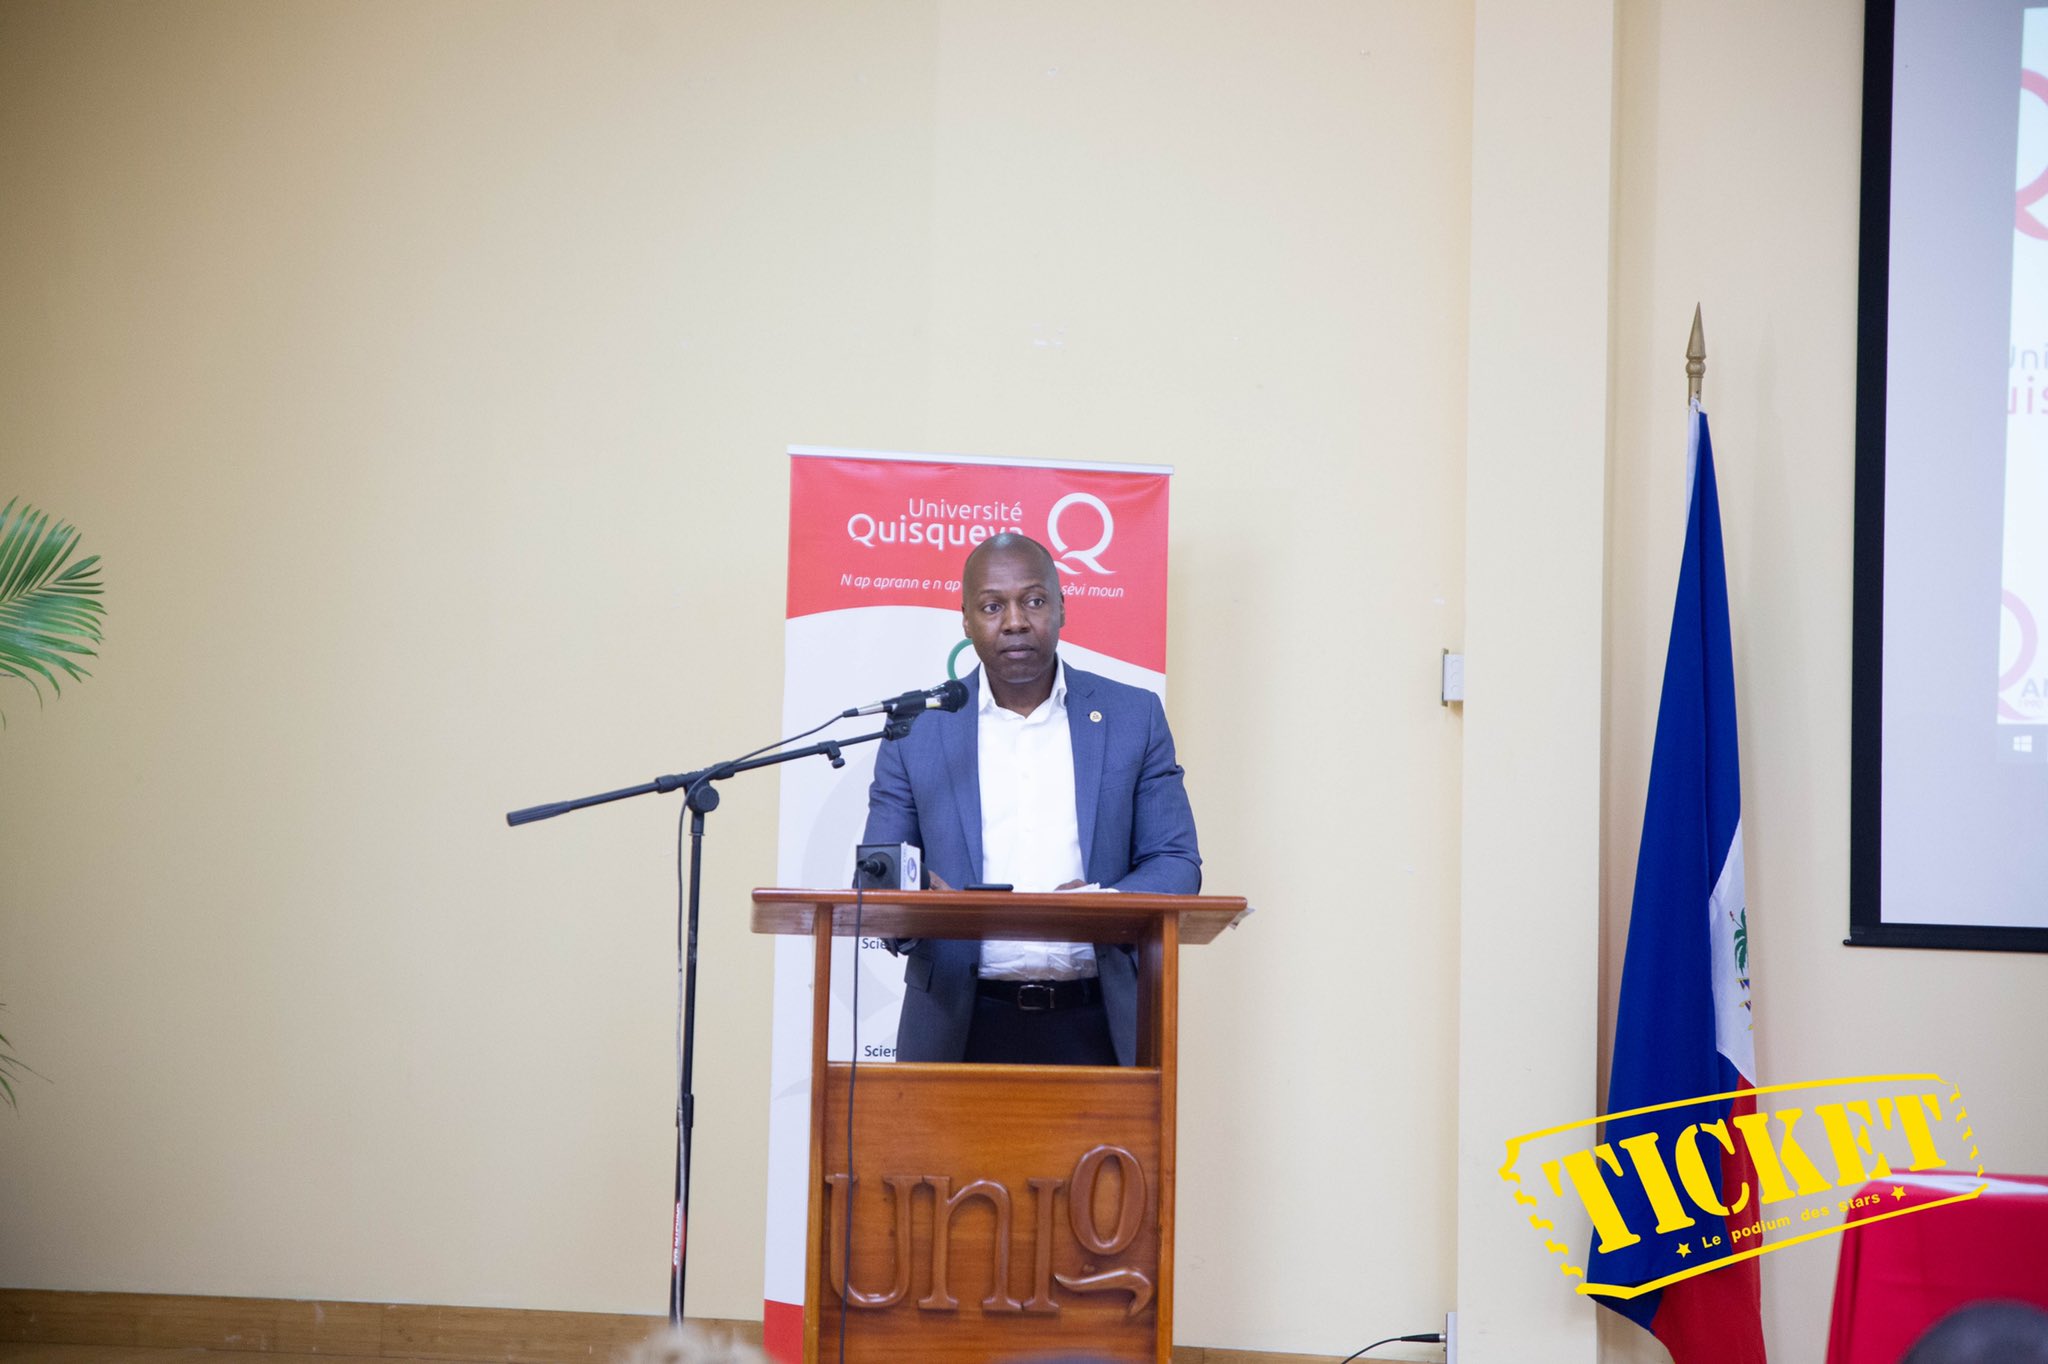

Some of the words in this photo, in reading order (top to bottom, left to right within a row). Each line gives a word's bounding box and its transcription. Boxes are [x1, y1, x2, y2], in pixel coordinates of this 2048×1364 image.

[908, 498, 1023, 522] Université
[840, 573, 853, 587] N
[854, 576, 871, 590] ap
[873, 577, 919, 591] aprann
[922, 579, 931, 590] e
[933, 580, 942, 590] n
[944, 580, 961, 593] ap
[1061, 582, 1086, 596] sèvi
[1088, 586, 1124, 597] moun
